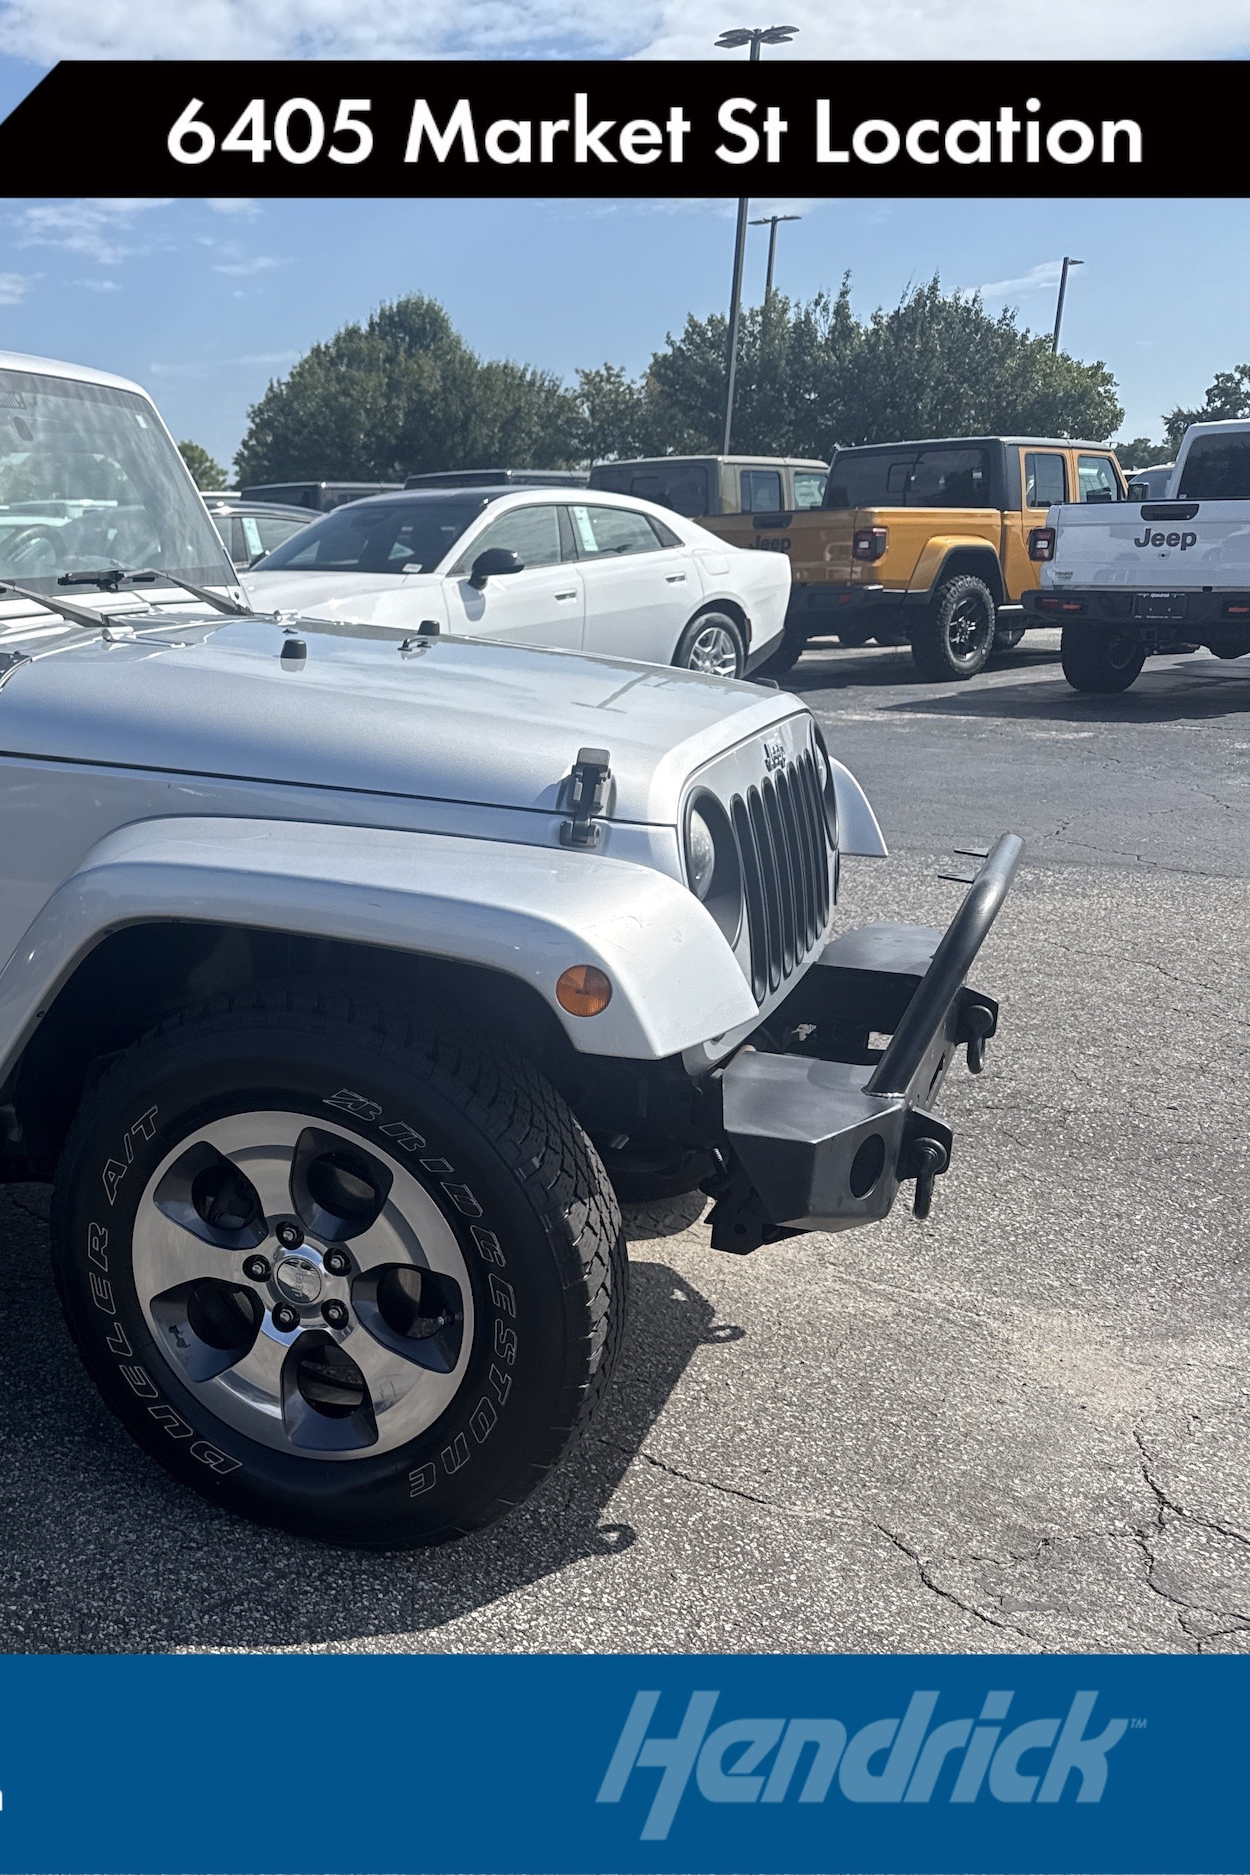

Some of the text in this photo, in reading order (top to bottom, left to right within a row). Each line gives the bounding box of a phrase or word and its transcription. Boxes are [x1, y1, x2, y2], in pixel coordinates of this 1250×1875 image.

[749, 535, 792, 553] Jeep
[1134, 528, 1197, 551] Jeep
[102, 1105, 159, 1206] A/T
[322, 1087, 519, 1499] BRIDGESTONE
[87, 1221, 245, 1476] DUELER
